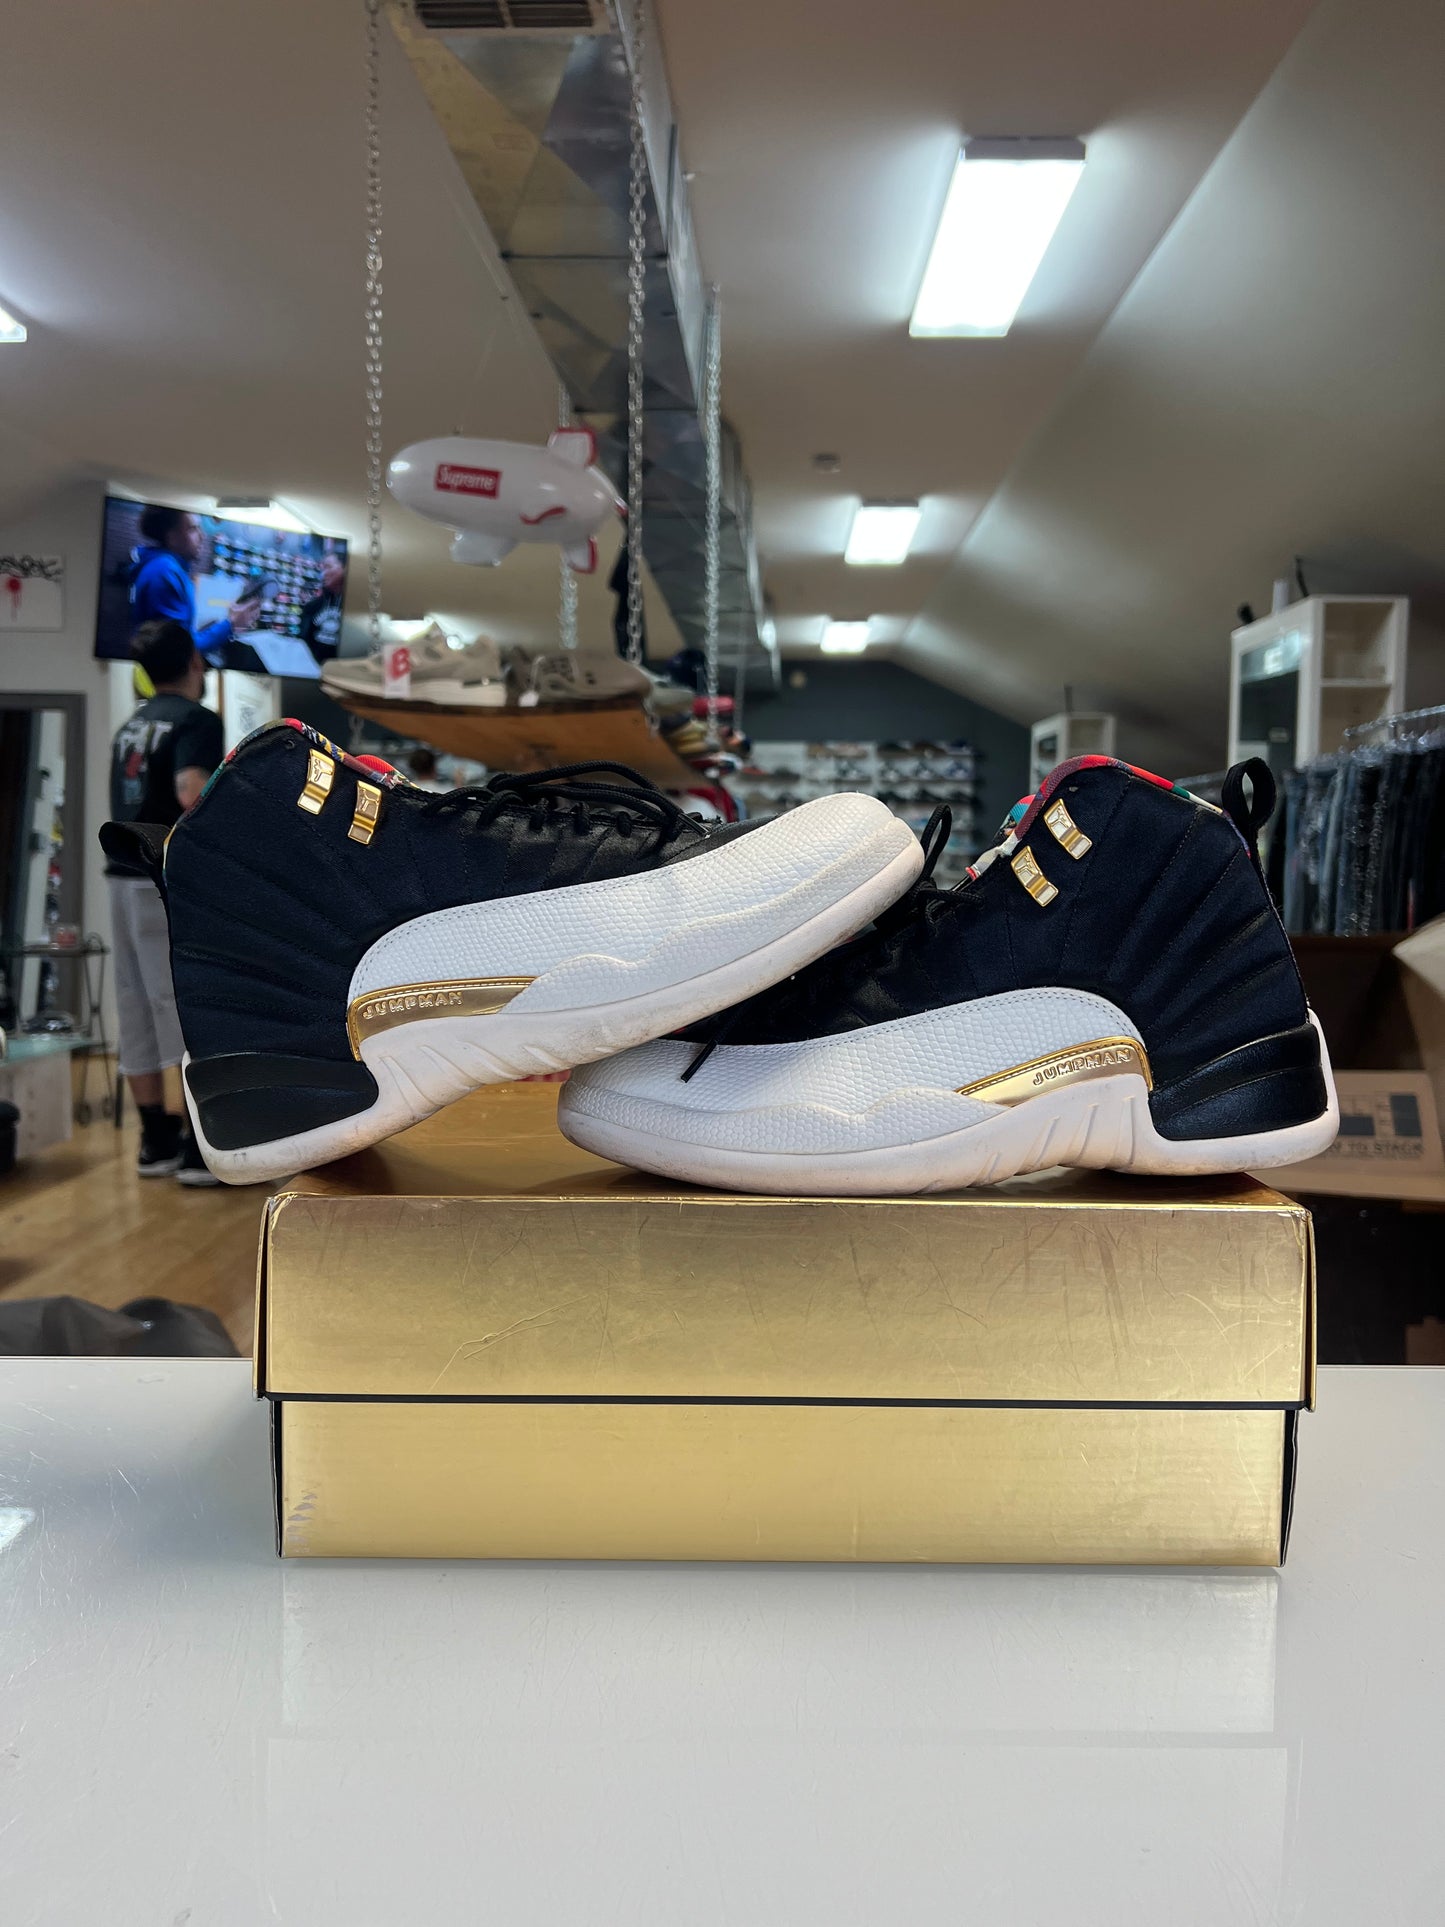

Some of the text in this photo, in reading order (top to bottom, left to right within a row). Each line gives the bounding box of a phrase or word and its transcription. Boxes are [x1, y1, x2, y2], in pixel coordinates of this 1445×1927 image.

[438, 465, 496, 491] Supreme
[362, 991, 463, 1019] JUMPMAN
[1032, 1048, 1132, 1086] JUMPMAN
